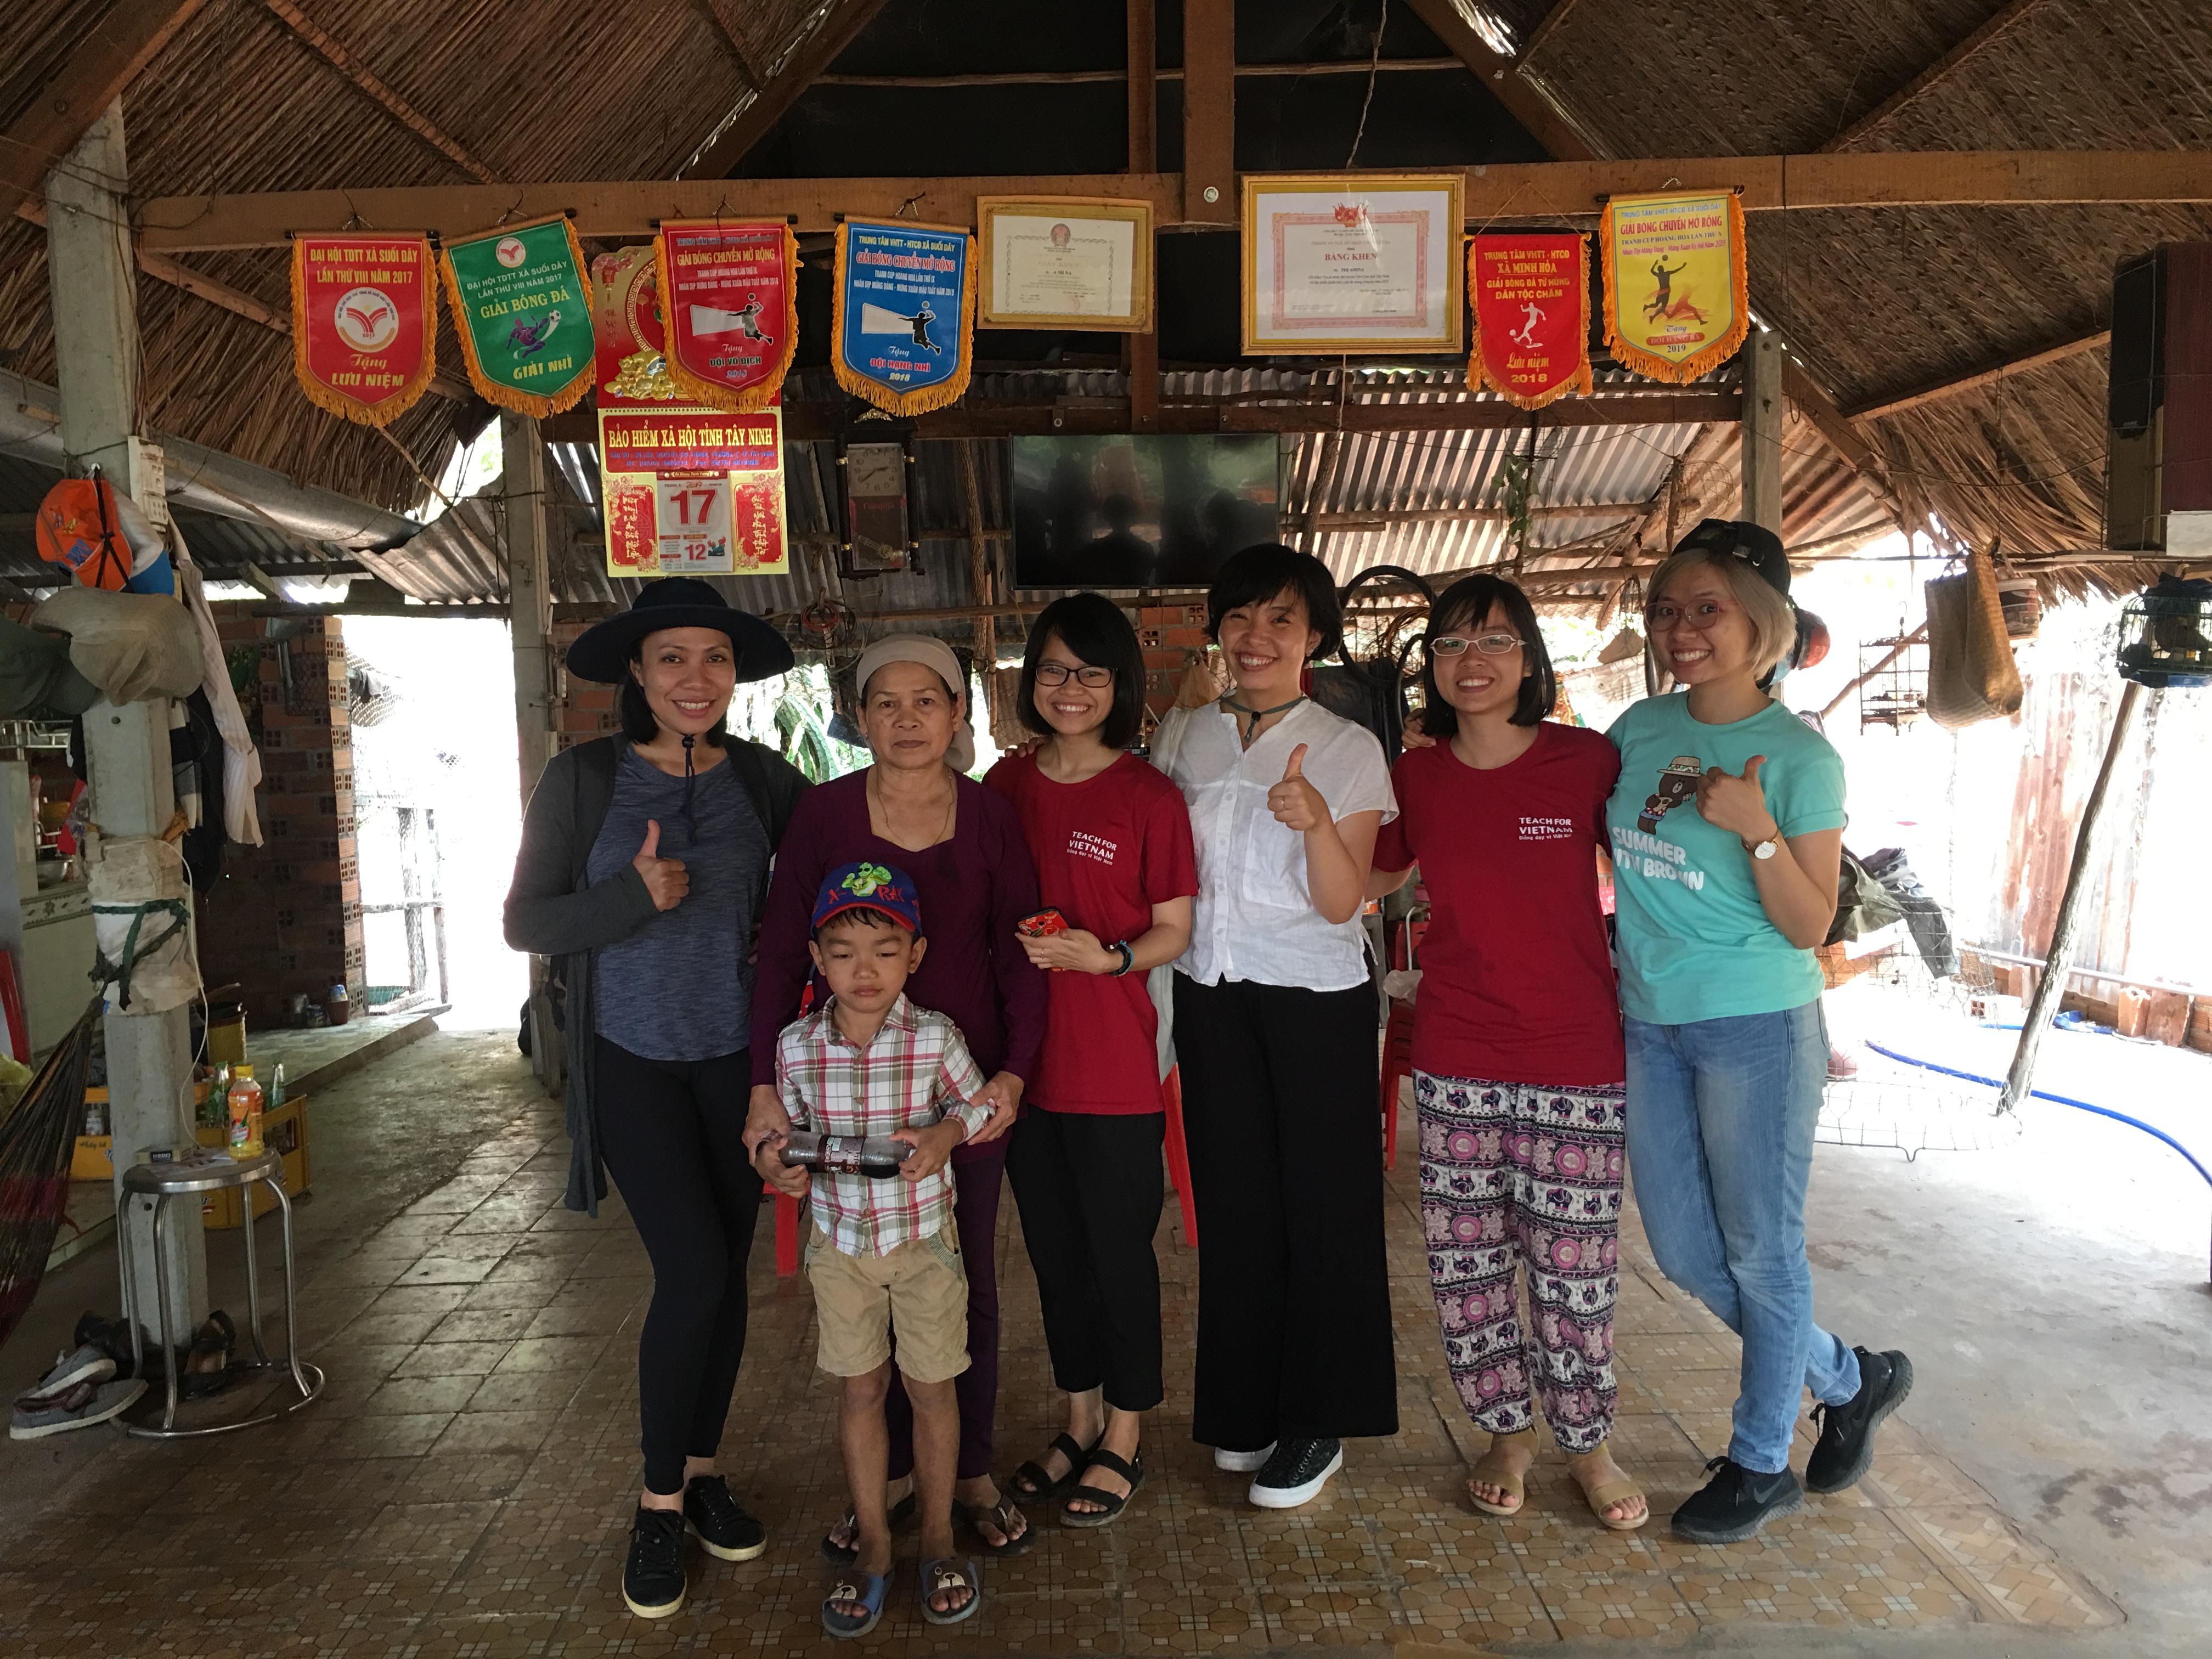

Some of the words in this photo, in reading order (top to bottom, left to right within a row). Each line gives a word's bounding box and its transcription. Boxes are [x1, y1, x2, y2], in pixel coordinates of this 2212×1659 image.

[859, 235, 877, 245] TRUNG
[878, 236, 889, 246] TÂM
[311, 249, 324, 264] ĐẠI
[328, 246, 341, 264] HỘI
[344, 249, 363, 262] TDTT
[366, 246, 377, 262] XÃ
[379, 245, 399, 262] SUỐI
[402, 247, 417, 263] DÂY
[677, 250, 692, 266] GIẢI
[693, 250, 712, 264] BÓNG
[713, 246, 741, 263] CHUYỀN
[743, 246, 754, 261] MỞ
[755, 246, 775, 262] RỘNG
[856, 247, 871, 264] GIẢI
[872, 250, 892, 267] BÓNG
[893, 251, 922, 269] CHUYỀN
[922, 254, 934, 270] MỞ
[935, 256, 955, 273] RỘNG
[1484, 251, 1508, 261] TRUNG
[1509, 249, 1526, 259] TÂM
[1526, 250, 1545, 259] VHTT
[1498, 259, 1510, 274] XÃ
[1513, 262, 1537, 274] MINH
[354, 270, 368, 283] VIII
[371, 268, 390, 283] NĂM
[393, 271, 413, 283] 2017
[467, 281, 481, 290] ĐẠI
[482, 276, 495, 286] HỘI
[496, 272, 516, 283] TDTT
[531, 263, 550, 275] SUỐI
[551, 261, 567, 271] DÂY
[512, 281, 525, 290] VIII
[527, 277, 544, 288] NĂM
[545, 273, 562, 283] 2017
[1487, 276, 1503, 289] GIẢI
[1505, 277, 1525, 287] BÓNG
[1526, 275, 1537, 287] ĐÁ
[480, 298, 509, 319] GIẢI
[510, 293, 548, 312] BÓNG
[549, 285, 571, 303] ĐÁ
[1496, 290, 1515, 300] DÂN
[1517, 289, 1534, 301] TỘC
[1667, 345, 1686, 353] 2019
[349, 354, 387, 370] Tặng
[512, 360, 543, 380] GIẢI
[548, 354, 573, 373] NHÌ
[709, 357, 725, 368] ĐỘI
[727, 357, 738, 366] VÔ
[741, 357, 761, 366] ĐỊCH
[870, 357, 886, 369] ĐỘI
[888, 359, 912, 371] HẠNG
[915, 362, 930, 372] NHÌ
[331, 371, 361, 386] LƯU
[365, 371, 404, 389] NIỆM
[1511, 374, 1548, 383] 2018
[608, 424, 629, 448] BẢO
[632, 419, 658, 447] HIỂM
[661, 425, 676, 447] XÃ
[678, 424, 696, 450] HỘI
[699, 422, 723, 447] TỈNH
[725, 424, 746, 446] TÂY
[748, 427, 773, 445] NINH
[670, 489, 718, 525] 17
[685, 544, 707, 561] 12
[1519, 826, 1573, 834] VIETNAM
[1069, 839, 1114, 860] VIETNAM
[1073, 831, 1101, 844] TEACH
[1102, 839, 1117, 851] FOR
[1612, 827, 1686, 866] SUMMER
